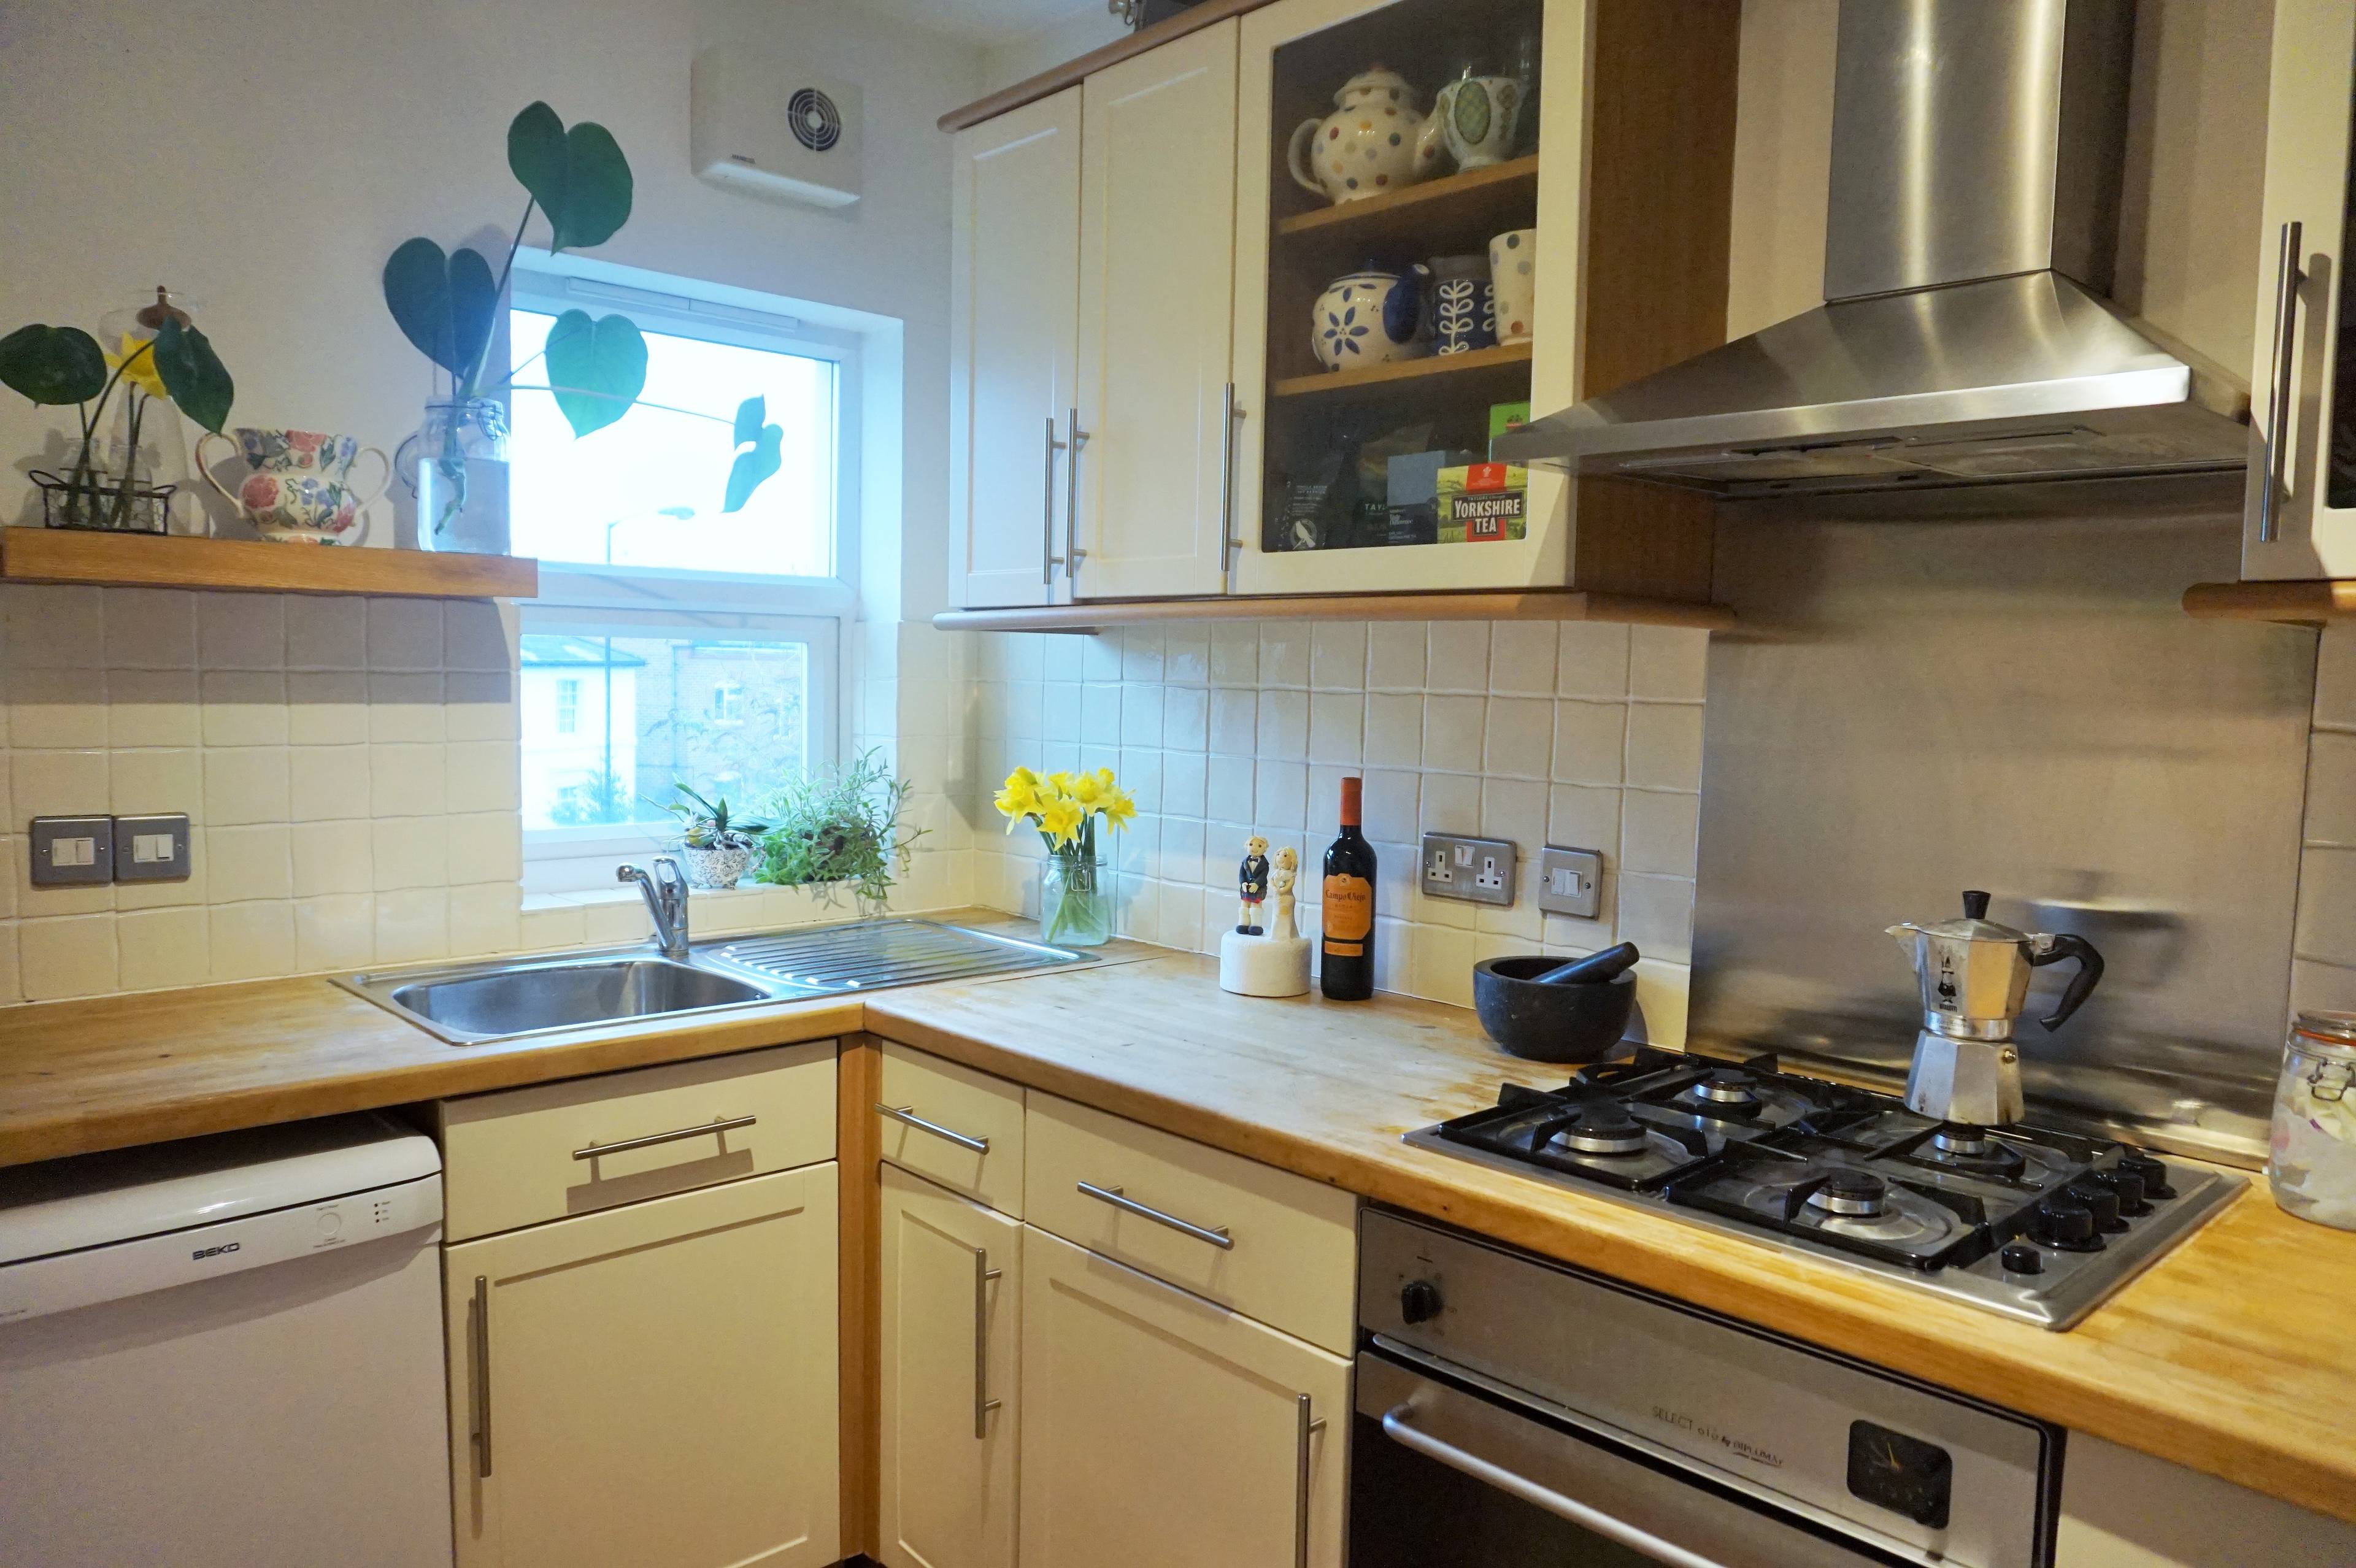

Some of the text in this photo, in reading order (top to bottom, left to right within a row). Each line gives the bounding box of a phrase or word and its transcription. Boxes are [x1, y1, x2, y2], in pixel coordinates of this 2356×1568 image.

[1454, 499, 1521, 518] YORKSHIRE
[1475, 517, 1497, 533] TEA
[1325, 890, 1366, 902] Campo Viejo
[192, 1242, 240, 1261] BEKO
